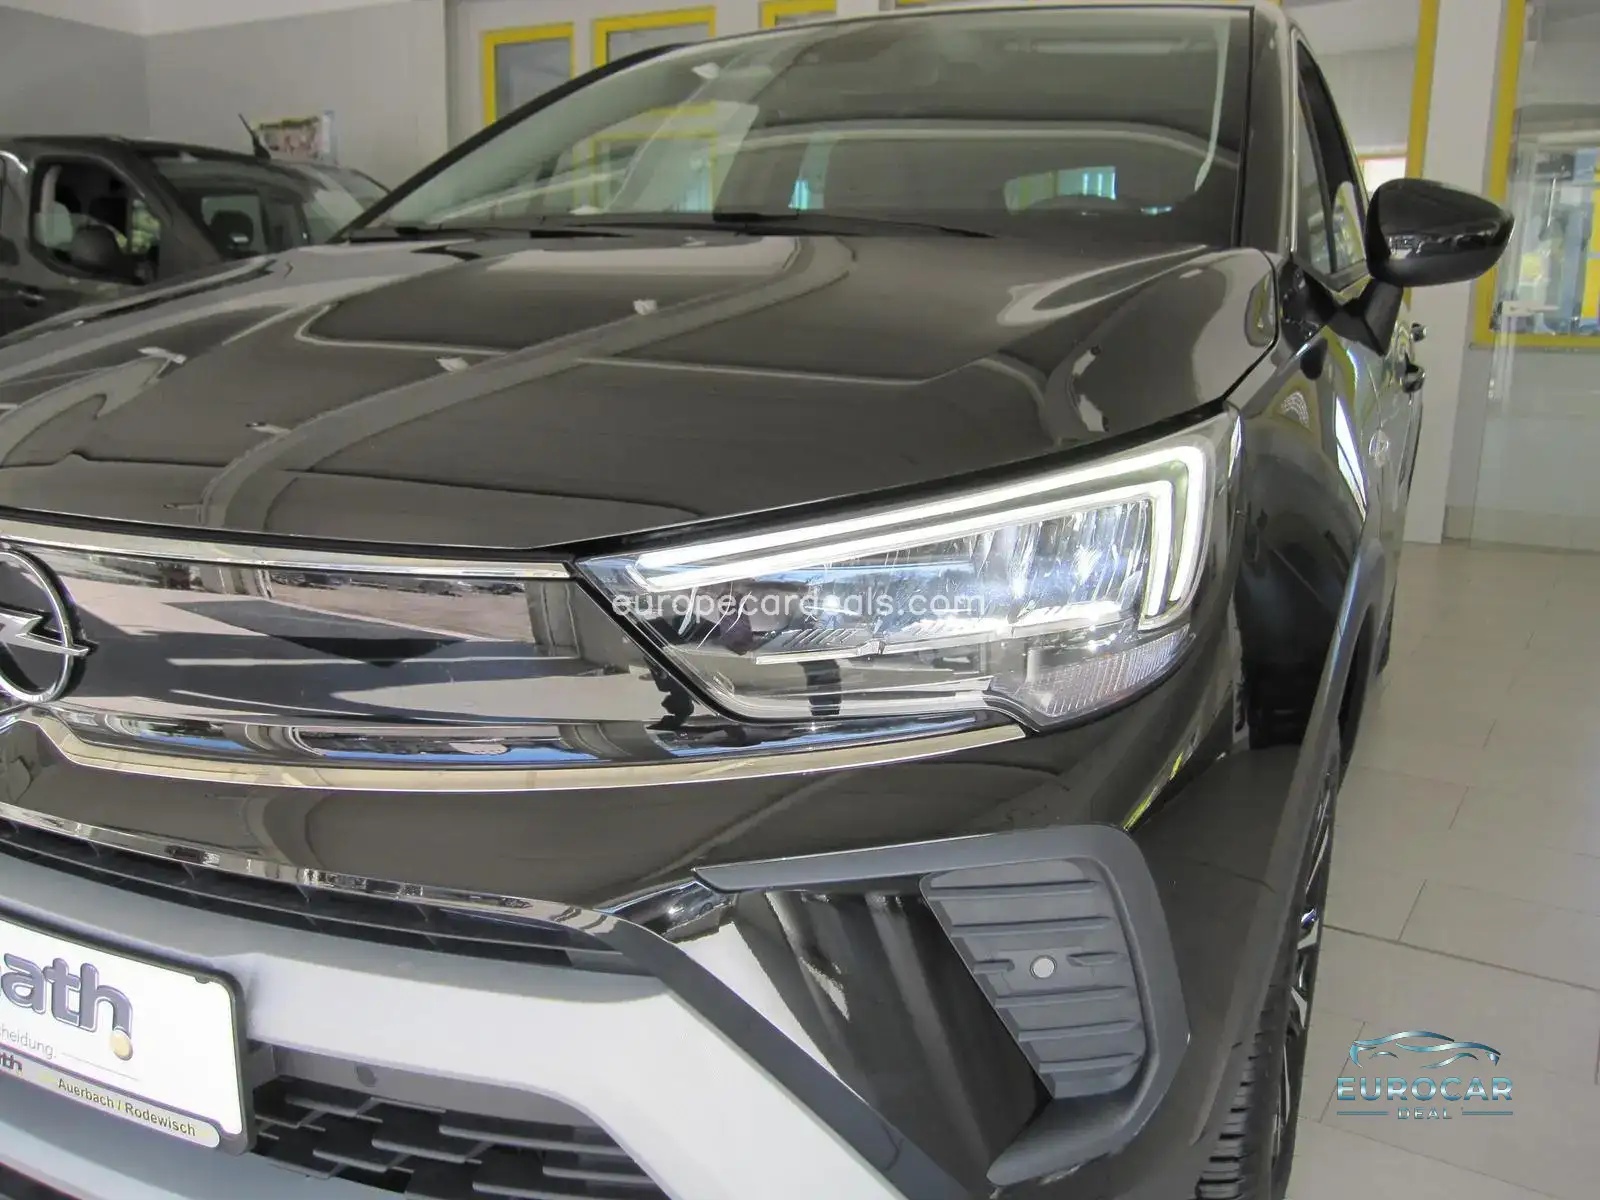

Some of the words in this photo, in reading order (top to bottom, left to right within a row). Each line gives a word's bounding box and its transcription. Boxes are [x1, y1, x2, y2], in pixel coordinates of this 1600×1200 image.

[0, 1023, 56, 1060] heidung.
[58, 1078, 114, 1108] Auerbach
[125, 1102, 197, 1137] Rodewisch
